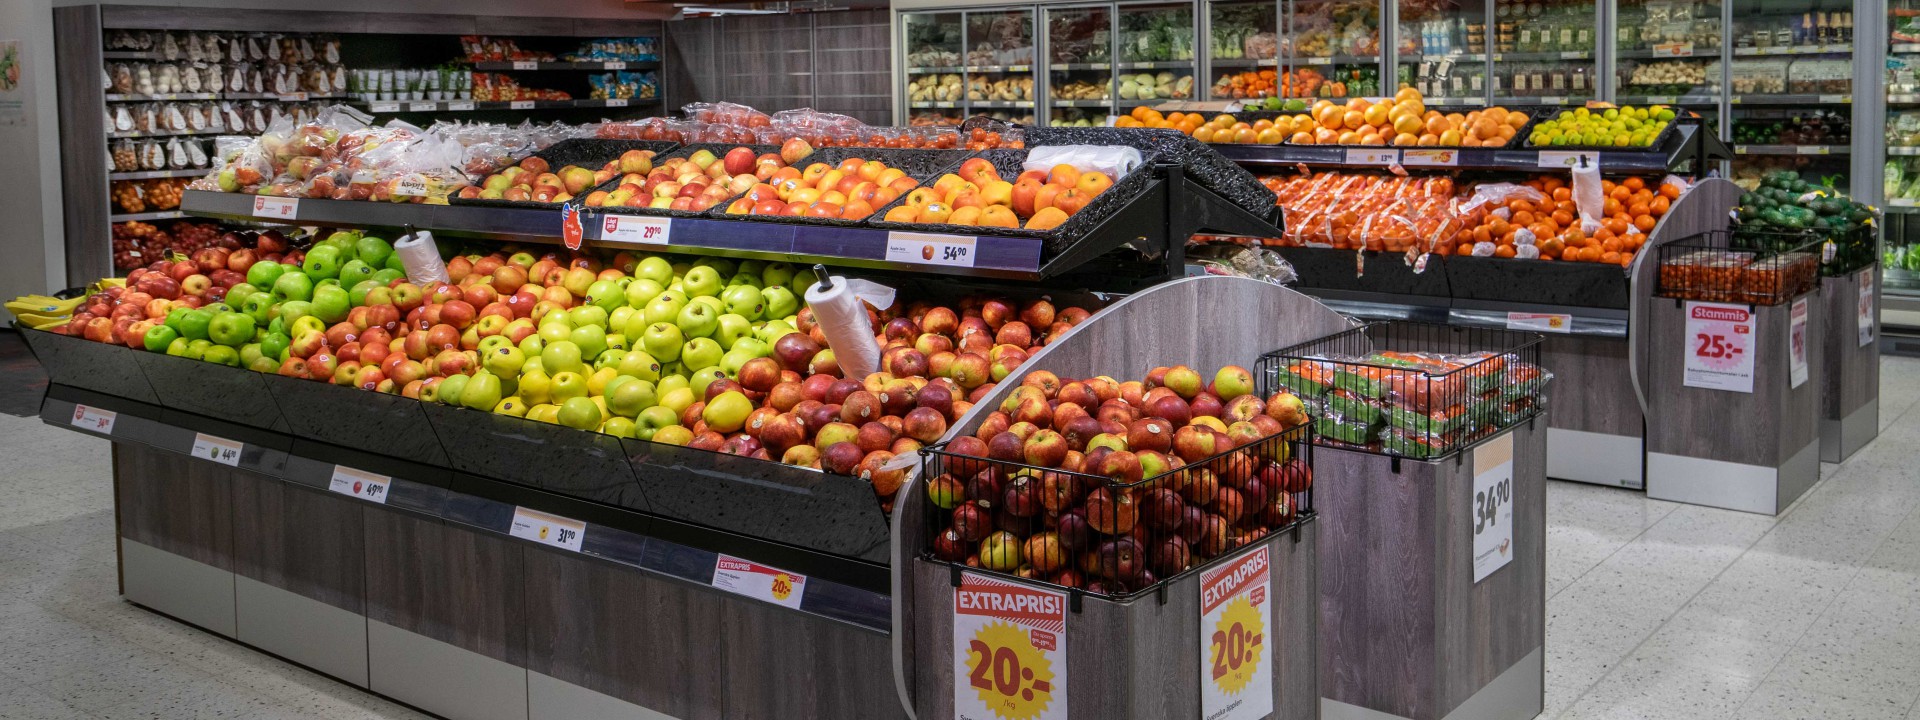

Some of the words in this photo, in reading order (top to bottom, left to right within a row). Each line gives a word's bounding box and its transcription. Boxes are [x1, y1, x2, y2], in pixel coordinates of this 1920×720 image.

[943, 245, 967, 261] 5490
[1694, 307, 1746, 321] Stammis
[1696, 333, 1743, 360] 25:-
[719, 561, 751, 571] EXTRAPRIS
[771, 579, 791, 595] 20:-
[1204, 549, 1267, 609] EXTRAPRIS!
[958, 590, 1062, 615] EXTRAPRIS!
[1211, 621, 1262, 682] 20:-
[969, 639, 1050, 702] 20:-
[1003, 699, 1016, 710] /kg
[1226, 699, 1243, 712] äpplen
